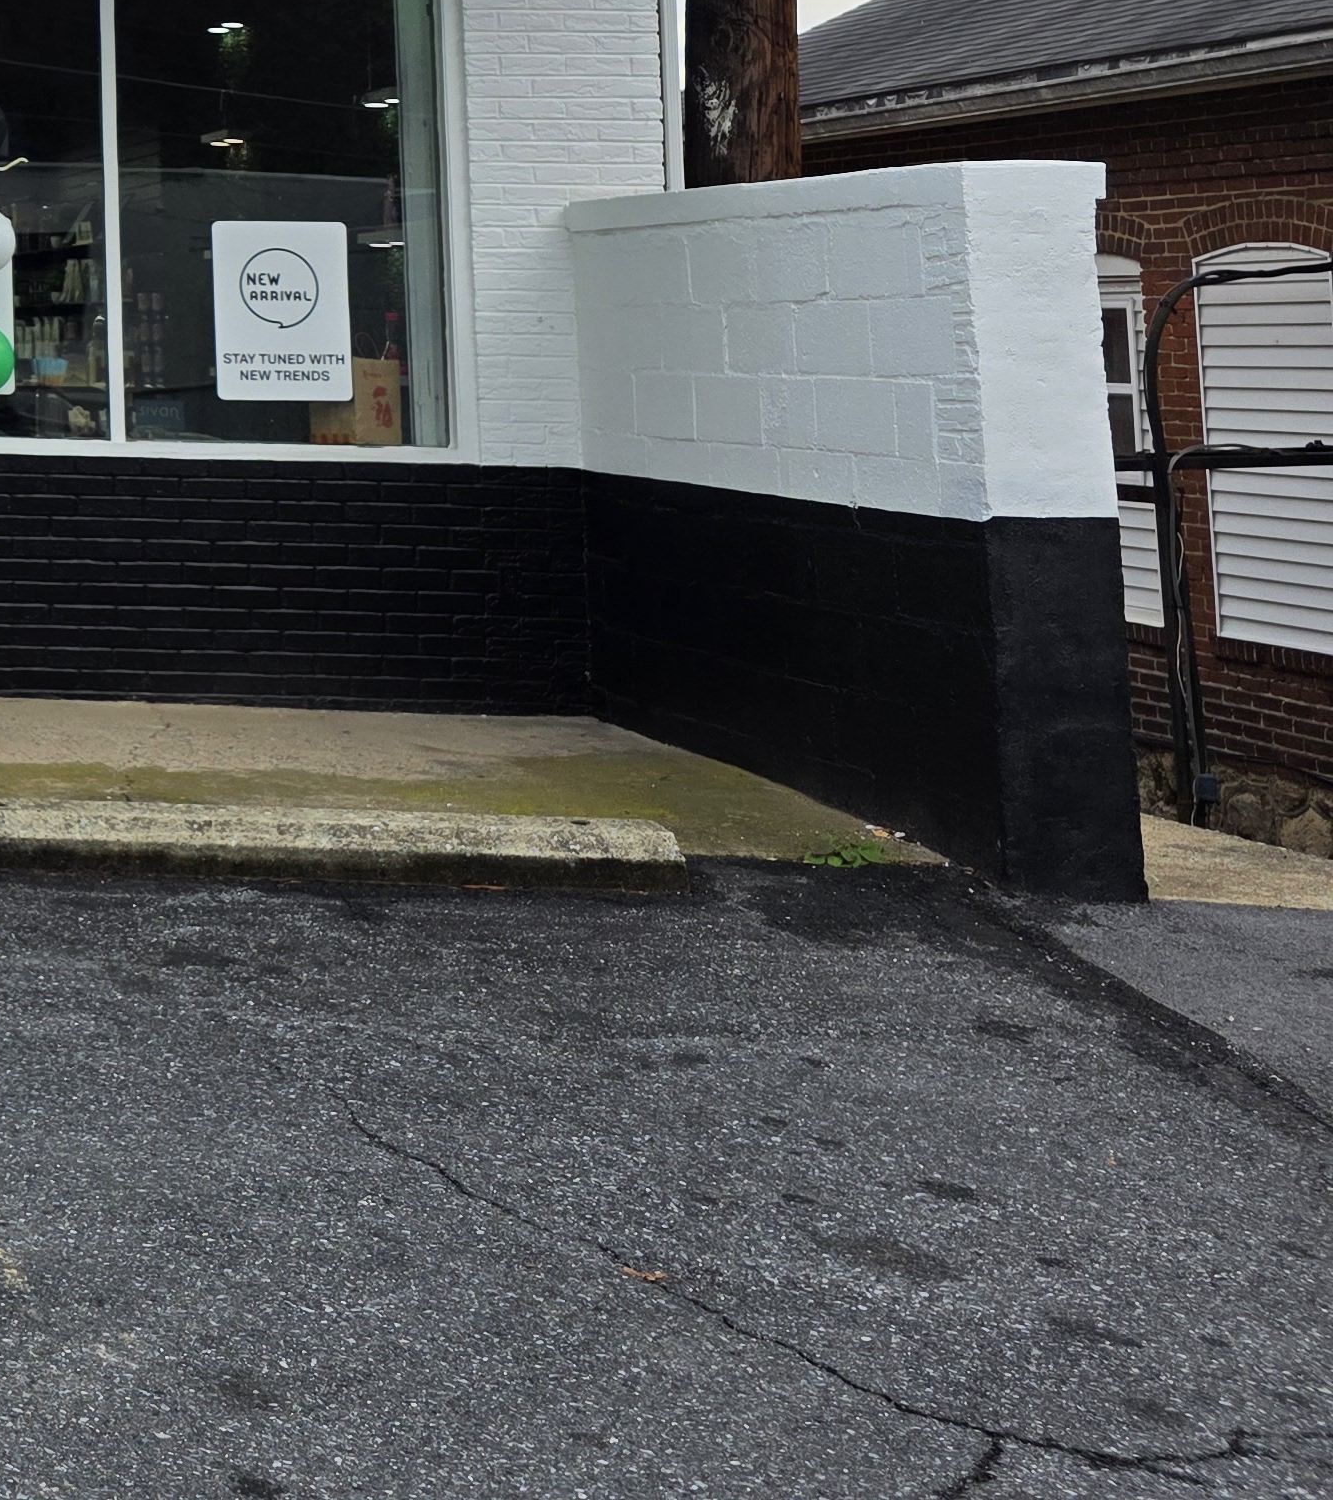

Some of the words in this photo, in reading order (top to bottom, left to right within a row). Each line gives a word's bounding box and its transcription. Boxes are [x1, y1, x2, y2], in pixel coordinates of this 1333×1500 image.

[246, 272, 281, 286] NEW
[250, 290, 312, 302] ARRIVAL
[222, 352, 256, 364] STAY
[259, 353, 306, 365] TUNED
[309, 354, 345, 365] WITH
[239, 370, 272, 381] NEW
[274, 370, 330, 382] TRENDS
